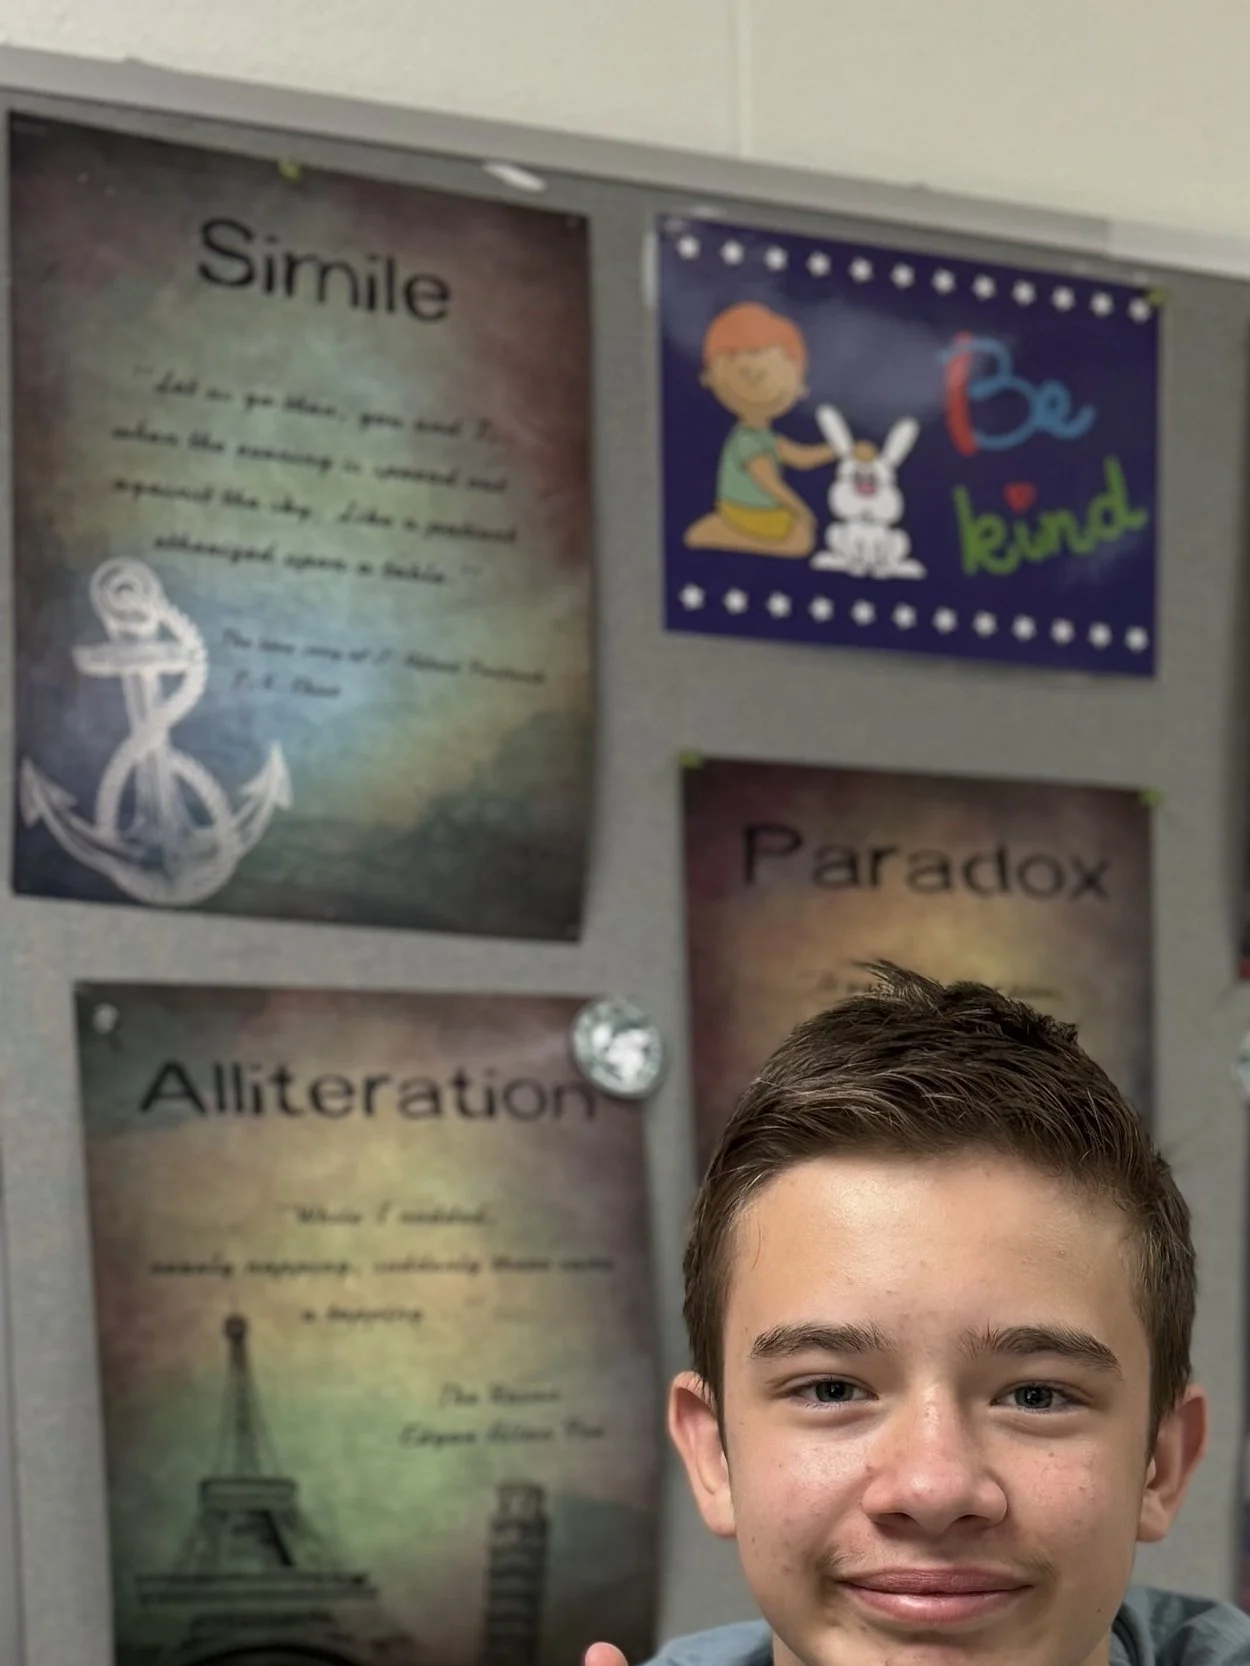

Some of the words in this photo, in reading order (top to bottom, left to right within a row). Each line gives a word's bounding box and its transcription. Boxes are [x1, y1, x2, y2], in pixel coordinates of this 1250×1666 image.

[198, 218, 453, 322] Simile
[935, 331, 1096, 457] Be
[952, 454, 1149, 576] kind
[741, 823, 1111, 899] Paradox
[138, 1060, 597, 1121] Alliteration
